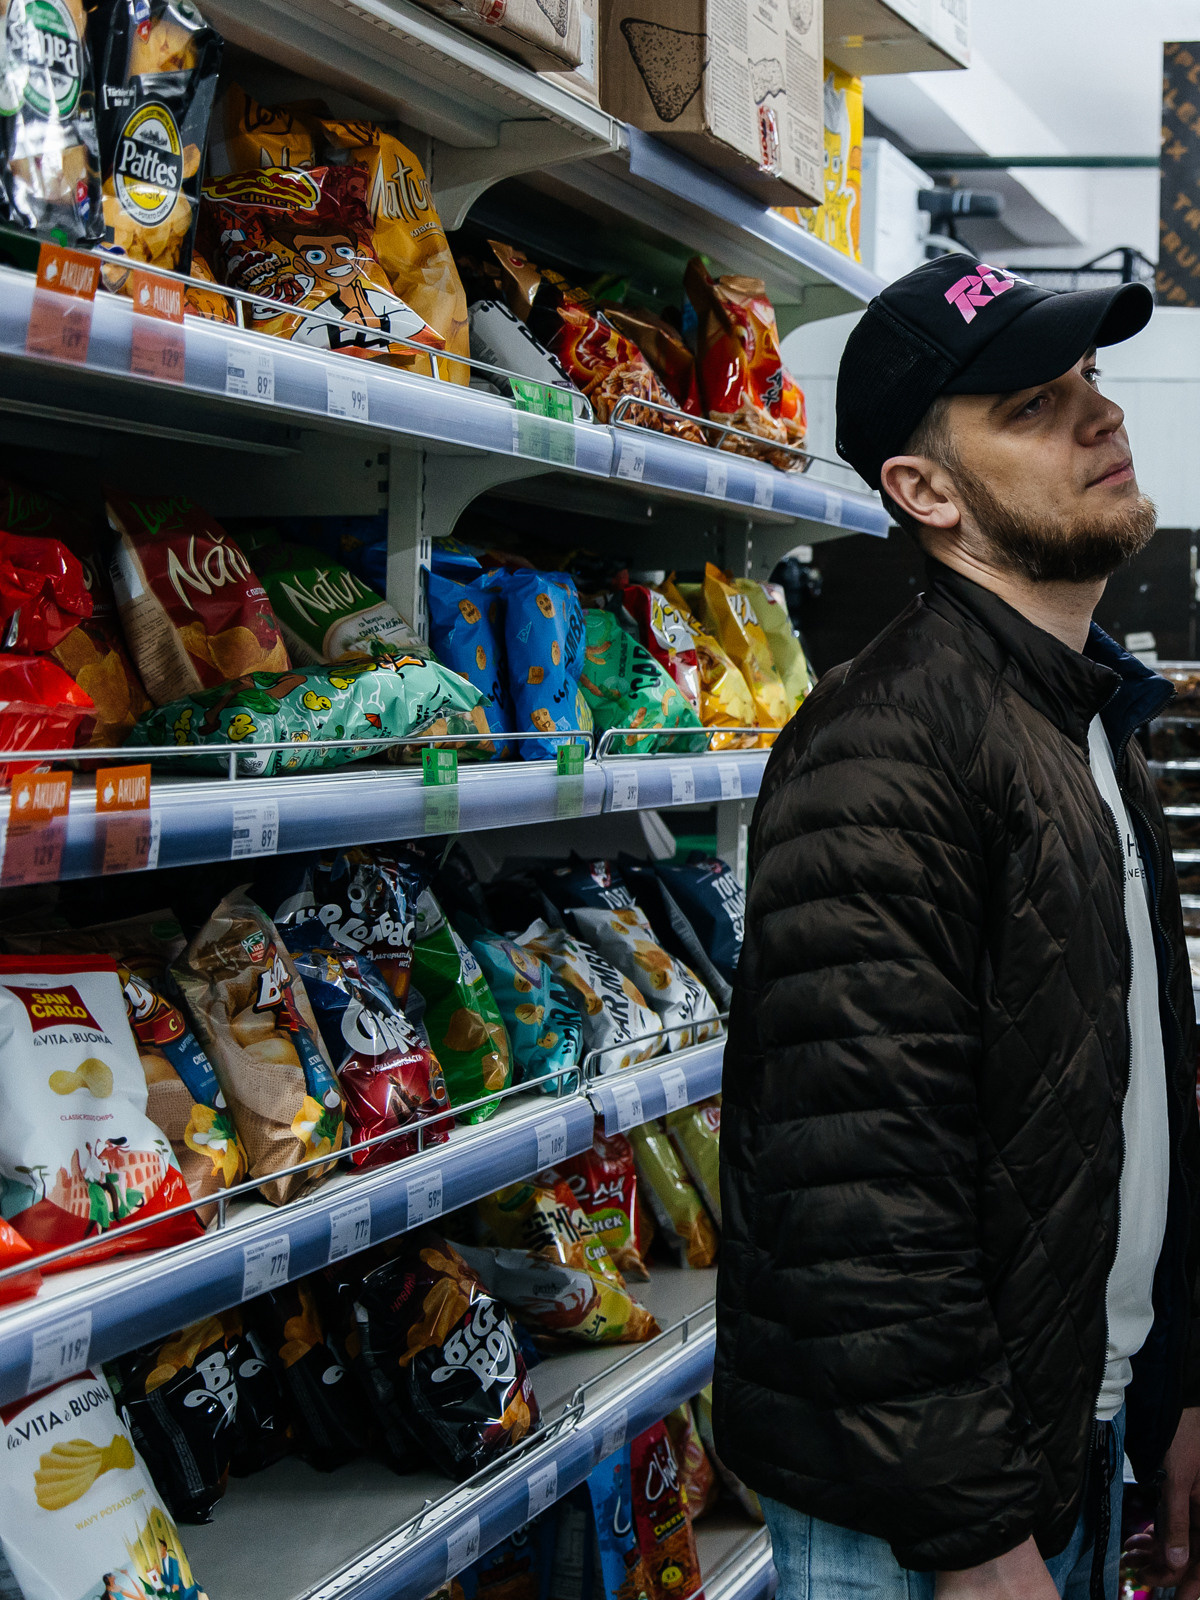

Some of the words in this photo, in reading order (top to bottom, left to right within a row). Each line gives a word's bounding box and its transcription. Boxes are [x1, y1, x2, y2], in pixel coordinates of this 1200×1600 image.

[118, 140, 178, 188] Pattes
[60, 261, 95, 294] АКЦИЯ
[153, 286, 181, 318] АКЦИЯ
[257, 376, 269, 395] 89
[351, 390, 363, 410] 99
[33, 782, 67, 813] АКЦИЯ
[117, 776, 147, 806] АКЦИЯ
[261, 830, 273, 849] 89
[31, 992, 73, 1005] SAN
[31, 1003, 88, 1020] CARLO
[40, 1033, 69, 1046] VITA
[74, 1031, 114, 1046] BUONA
[428, 1191, 441, 1208] 59
[353, 1221, 365, 1240] 77
[270, 1254, 283, 1275] 77
[443, 1299, 499, 1365] BIG
[60, 1338, 82, 1366] 119
[14, 1409, 64, 1442] VITA
[68, 1385, 112, 1418] BUONA
[74, 1513, 100, 1532] WAVY
[99, 1495, 133, 1518] POTATO
